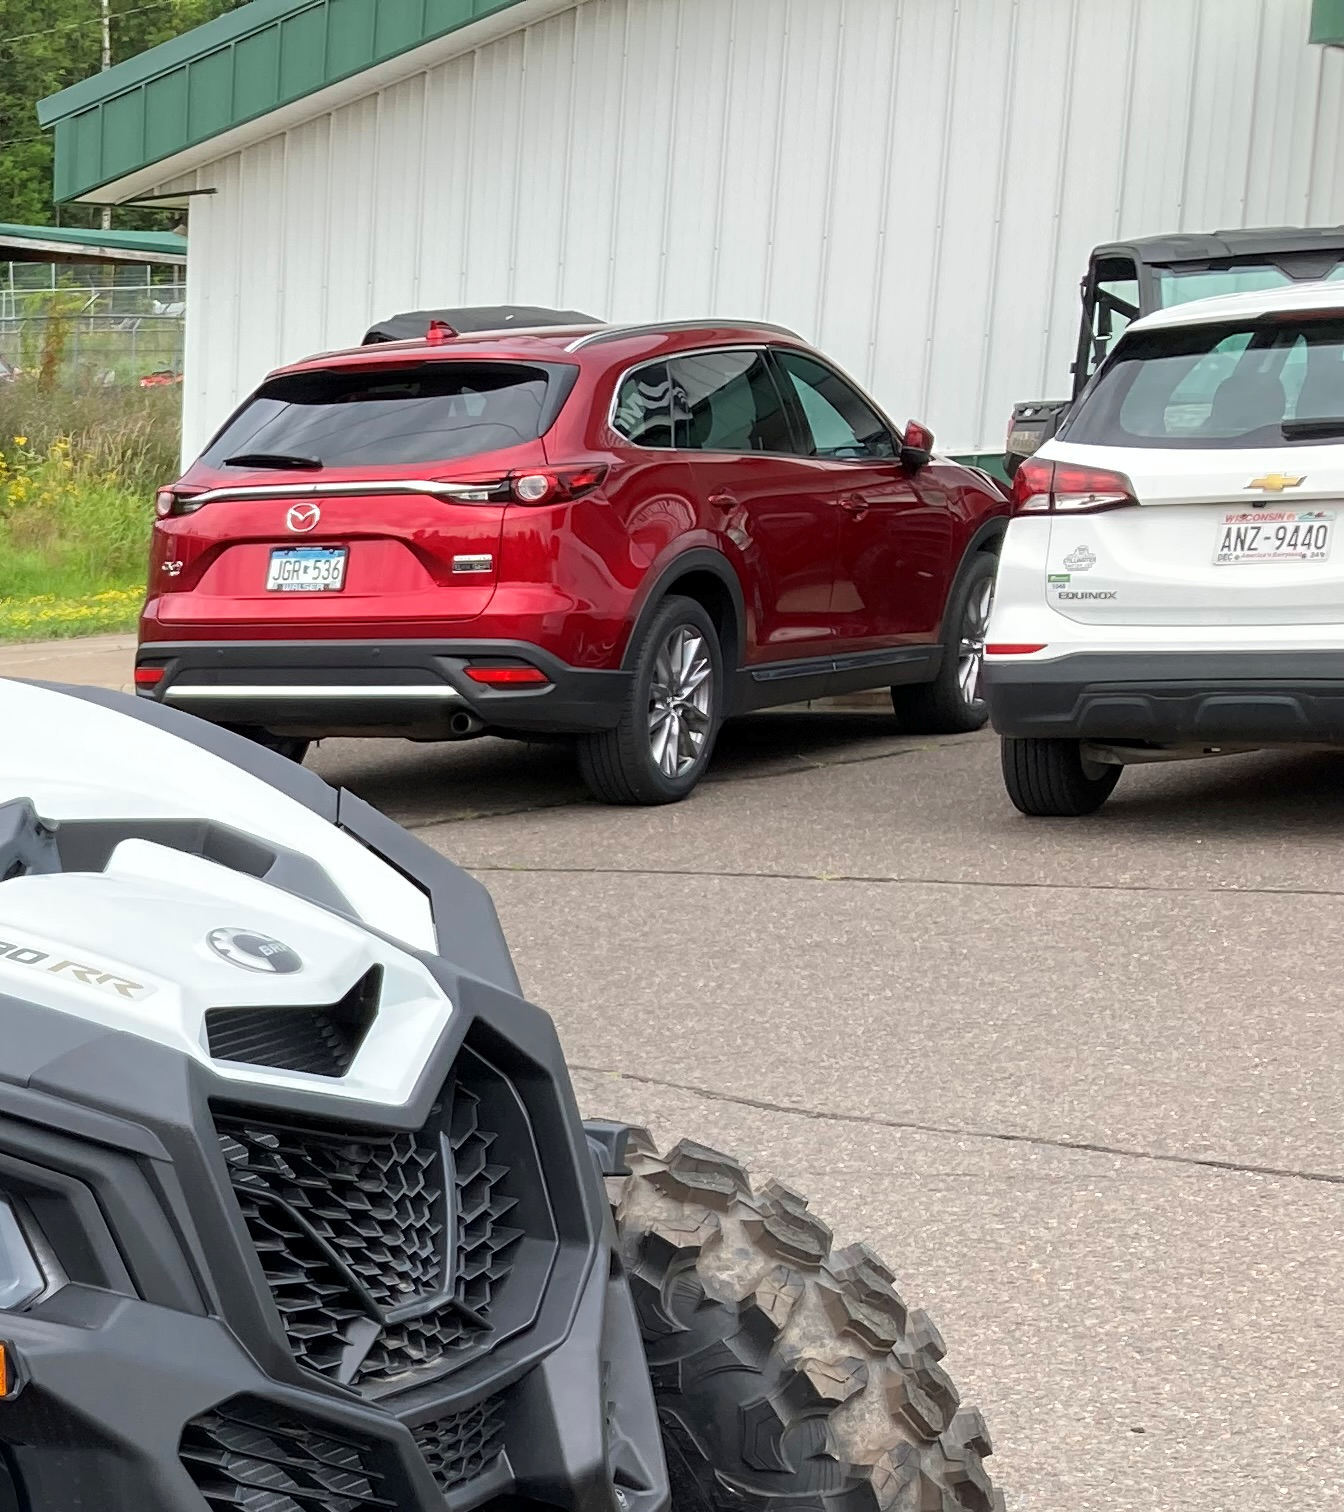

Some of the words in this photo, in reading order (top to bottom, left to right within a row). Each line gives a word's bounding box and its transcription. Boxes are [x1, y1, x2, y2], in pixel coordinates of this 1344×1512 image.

[1225, 513, 1285, 523] WISCONSIN
[1220, 525, 1328, 552] ANZ-9440
[273, 560, 301, 580] JGR
[312, 559, 340, 580] 536
[1058, 591, 1118, 600] EQUINOX
[47, 960, 144, 998] RR
